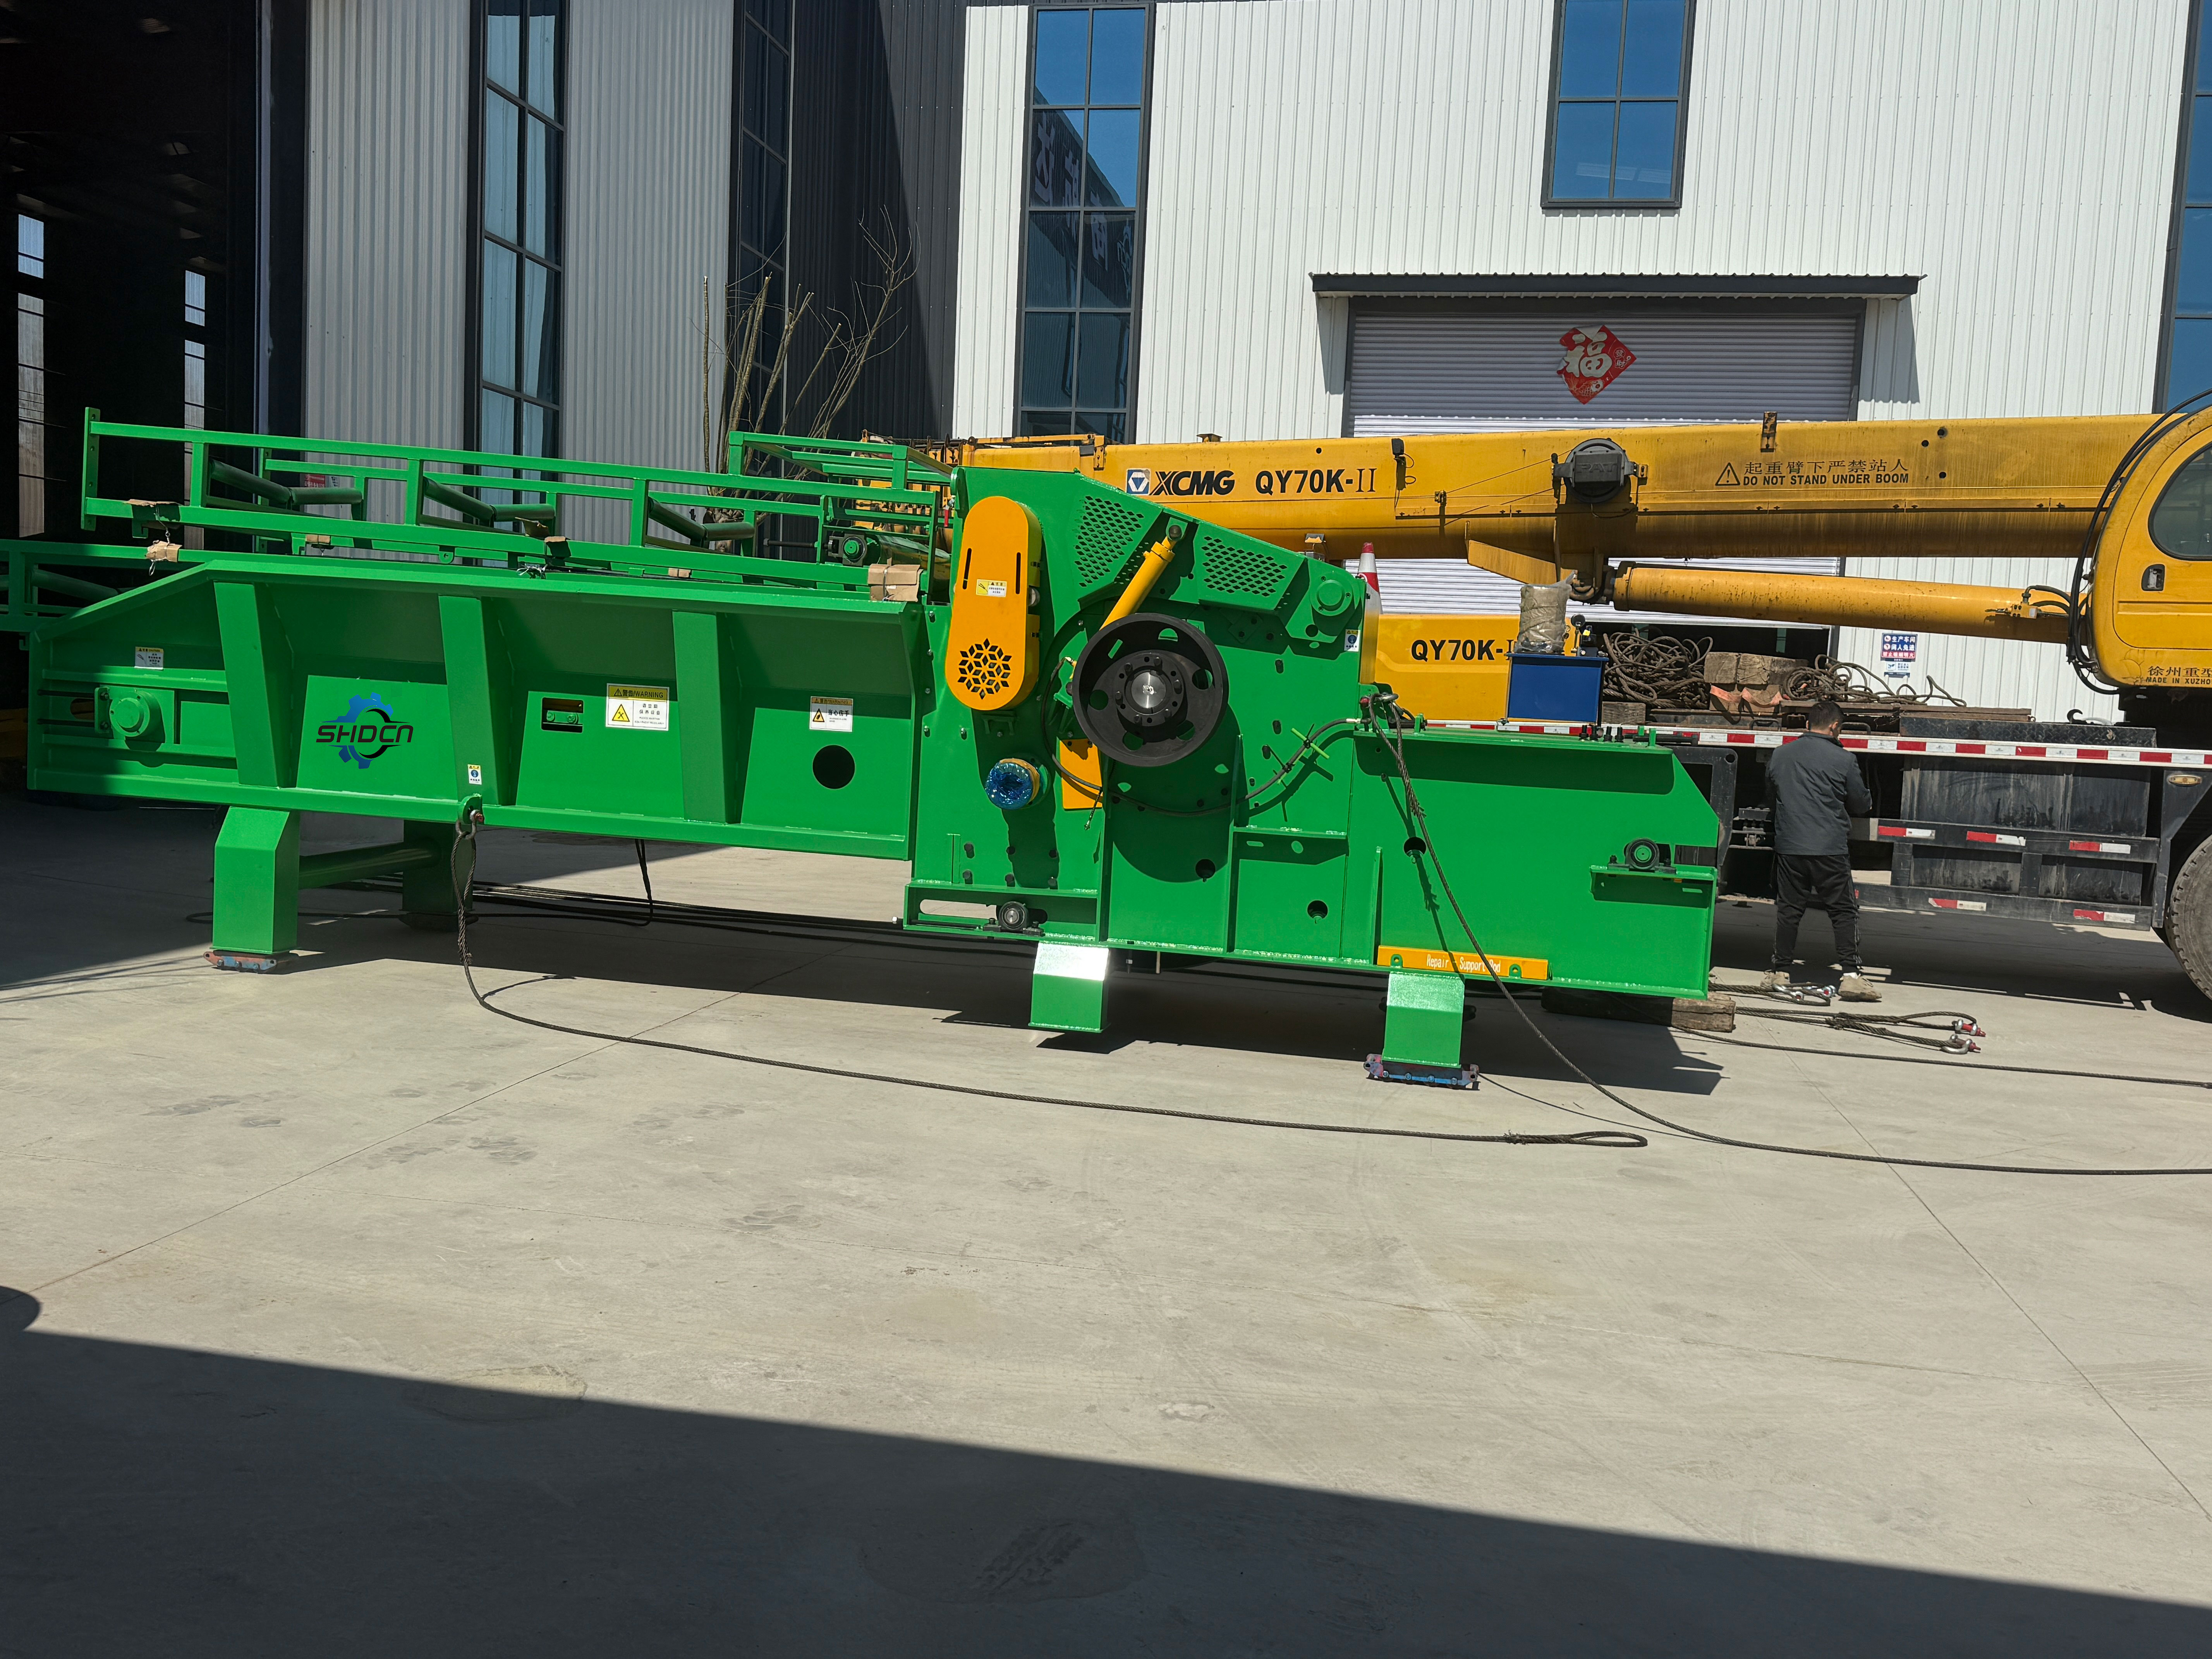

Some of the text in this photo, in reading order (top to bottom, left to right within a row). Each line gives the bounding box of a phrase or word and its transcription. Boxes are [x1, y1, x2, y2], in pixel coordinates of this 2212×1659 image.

[1564, 331, 1613, 378] 福
[1576, 462, 1618, 473] PAT
[1744, 459, 1909, 475] 起重臂下严禁站人
[1149, 470, 1235, 496] XCMG
[1743, 473, 1909, 485] DO NOT STAND UNDER BOOM
[1412, 640, 1516, 662] QY70K-I
[2147, 666, 2212, 677] 徐州重型
[1427, 954, 1449, 969] Repair
[1459, 956, 1486, 973] Support
